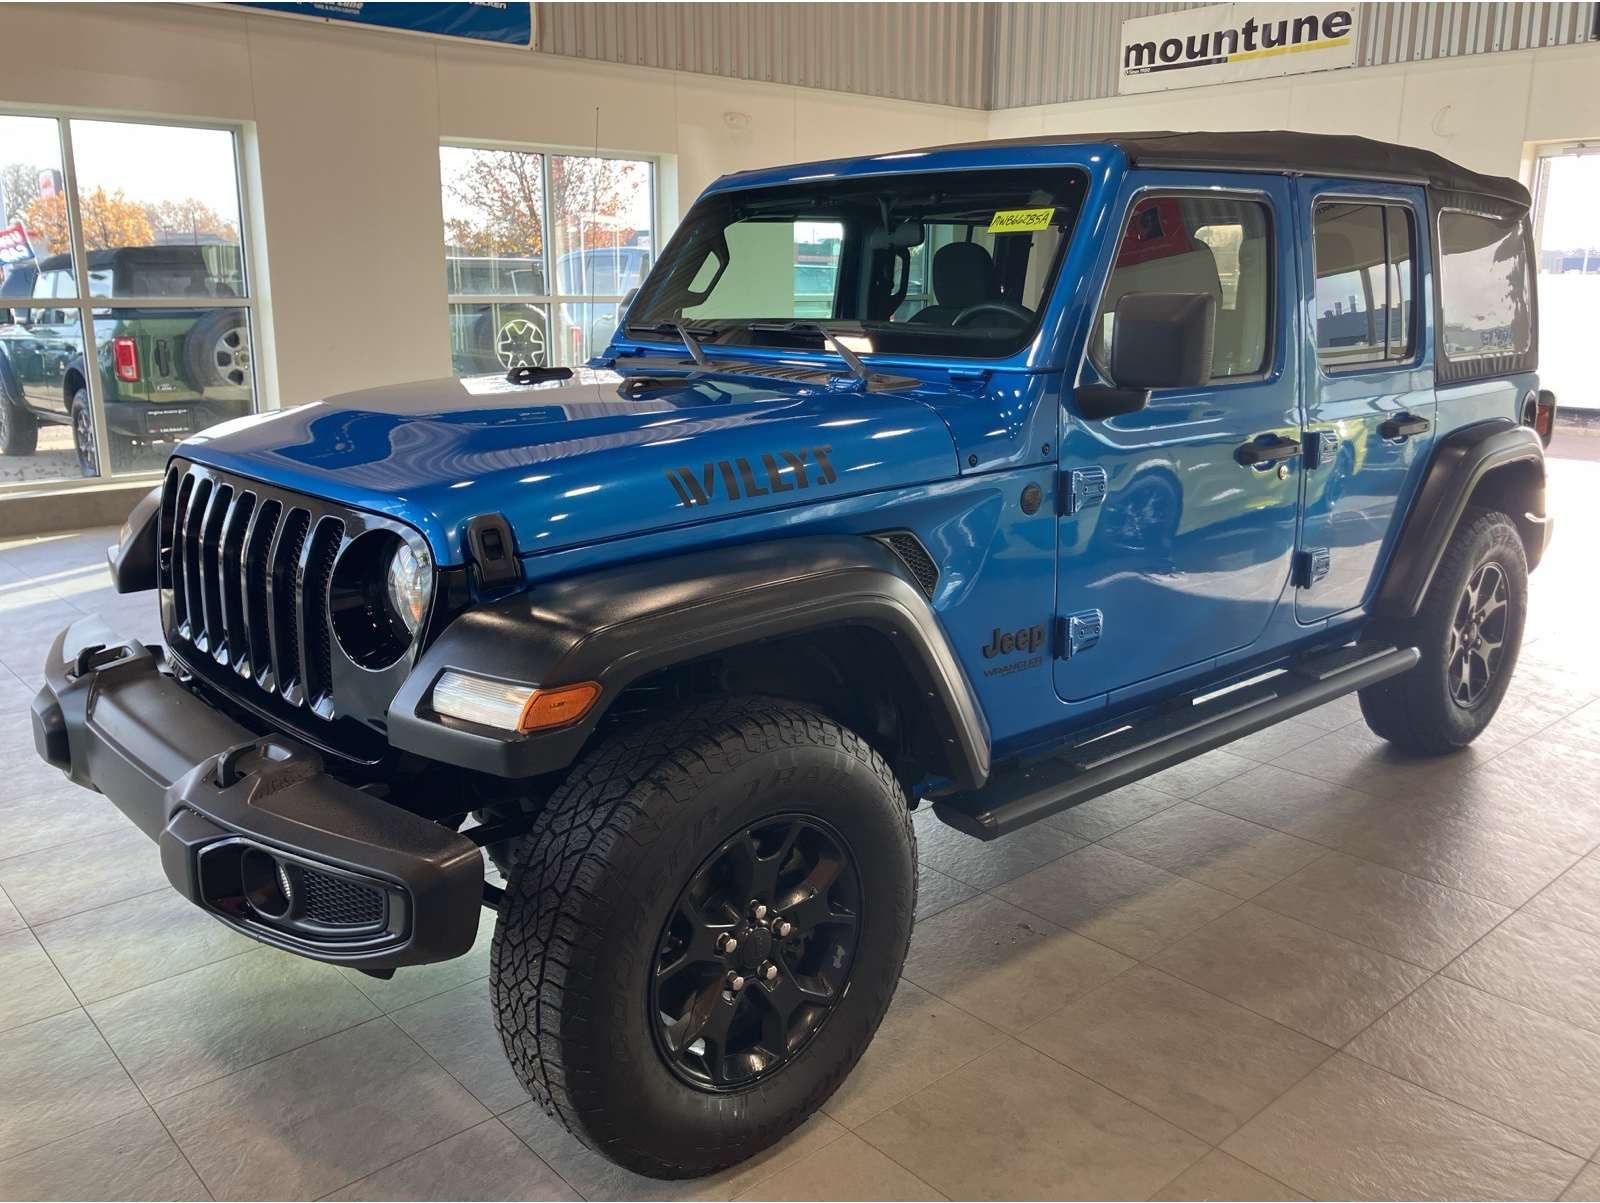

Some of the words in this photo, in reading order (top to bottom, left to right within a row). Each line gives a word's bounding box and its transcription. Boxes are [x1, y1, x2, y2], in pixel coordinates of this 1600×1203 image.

[1124, 10, 1353, 68] mountune
[663, 444, 838, 508] WILLYS
[982, 624, 1043, 659] Jeep
